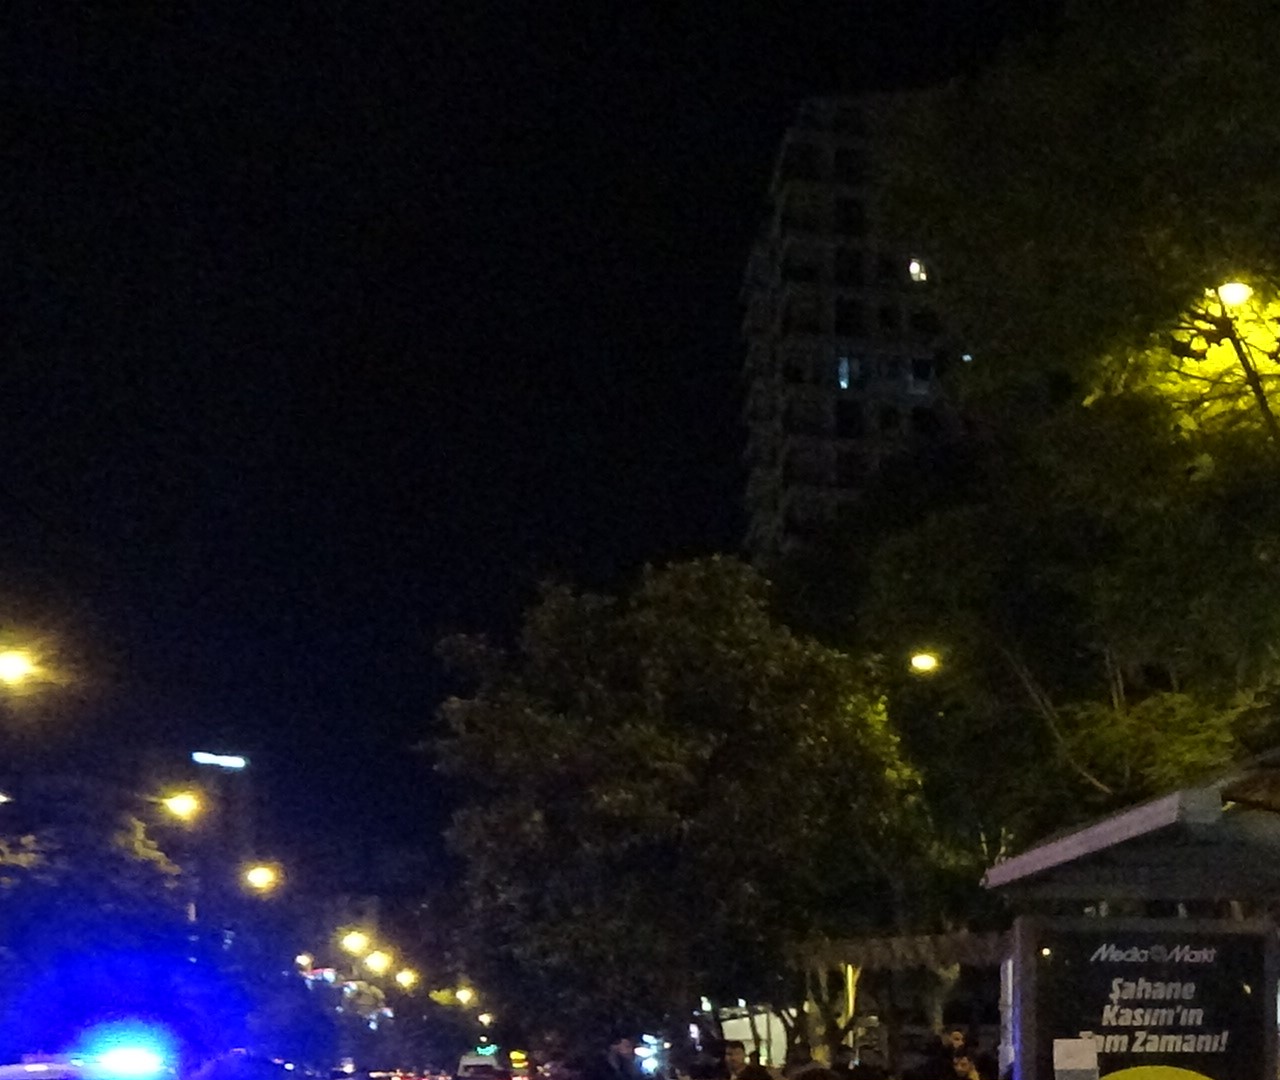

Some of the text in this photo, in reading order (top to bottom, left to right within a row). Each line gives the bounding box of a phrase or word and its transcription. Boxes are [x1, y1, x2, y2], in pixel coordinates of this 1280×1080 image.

[1090, 942, 1217, 964] Media Markt
[1108, 977, 1197, 1006] Şahane
[1101, 1004, 1205, 1027] Kasım'ın
[1130, 1029, 1229, 1054] Zamanı!
